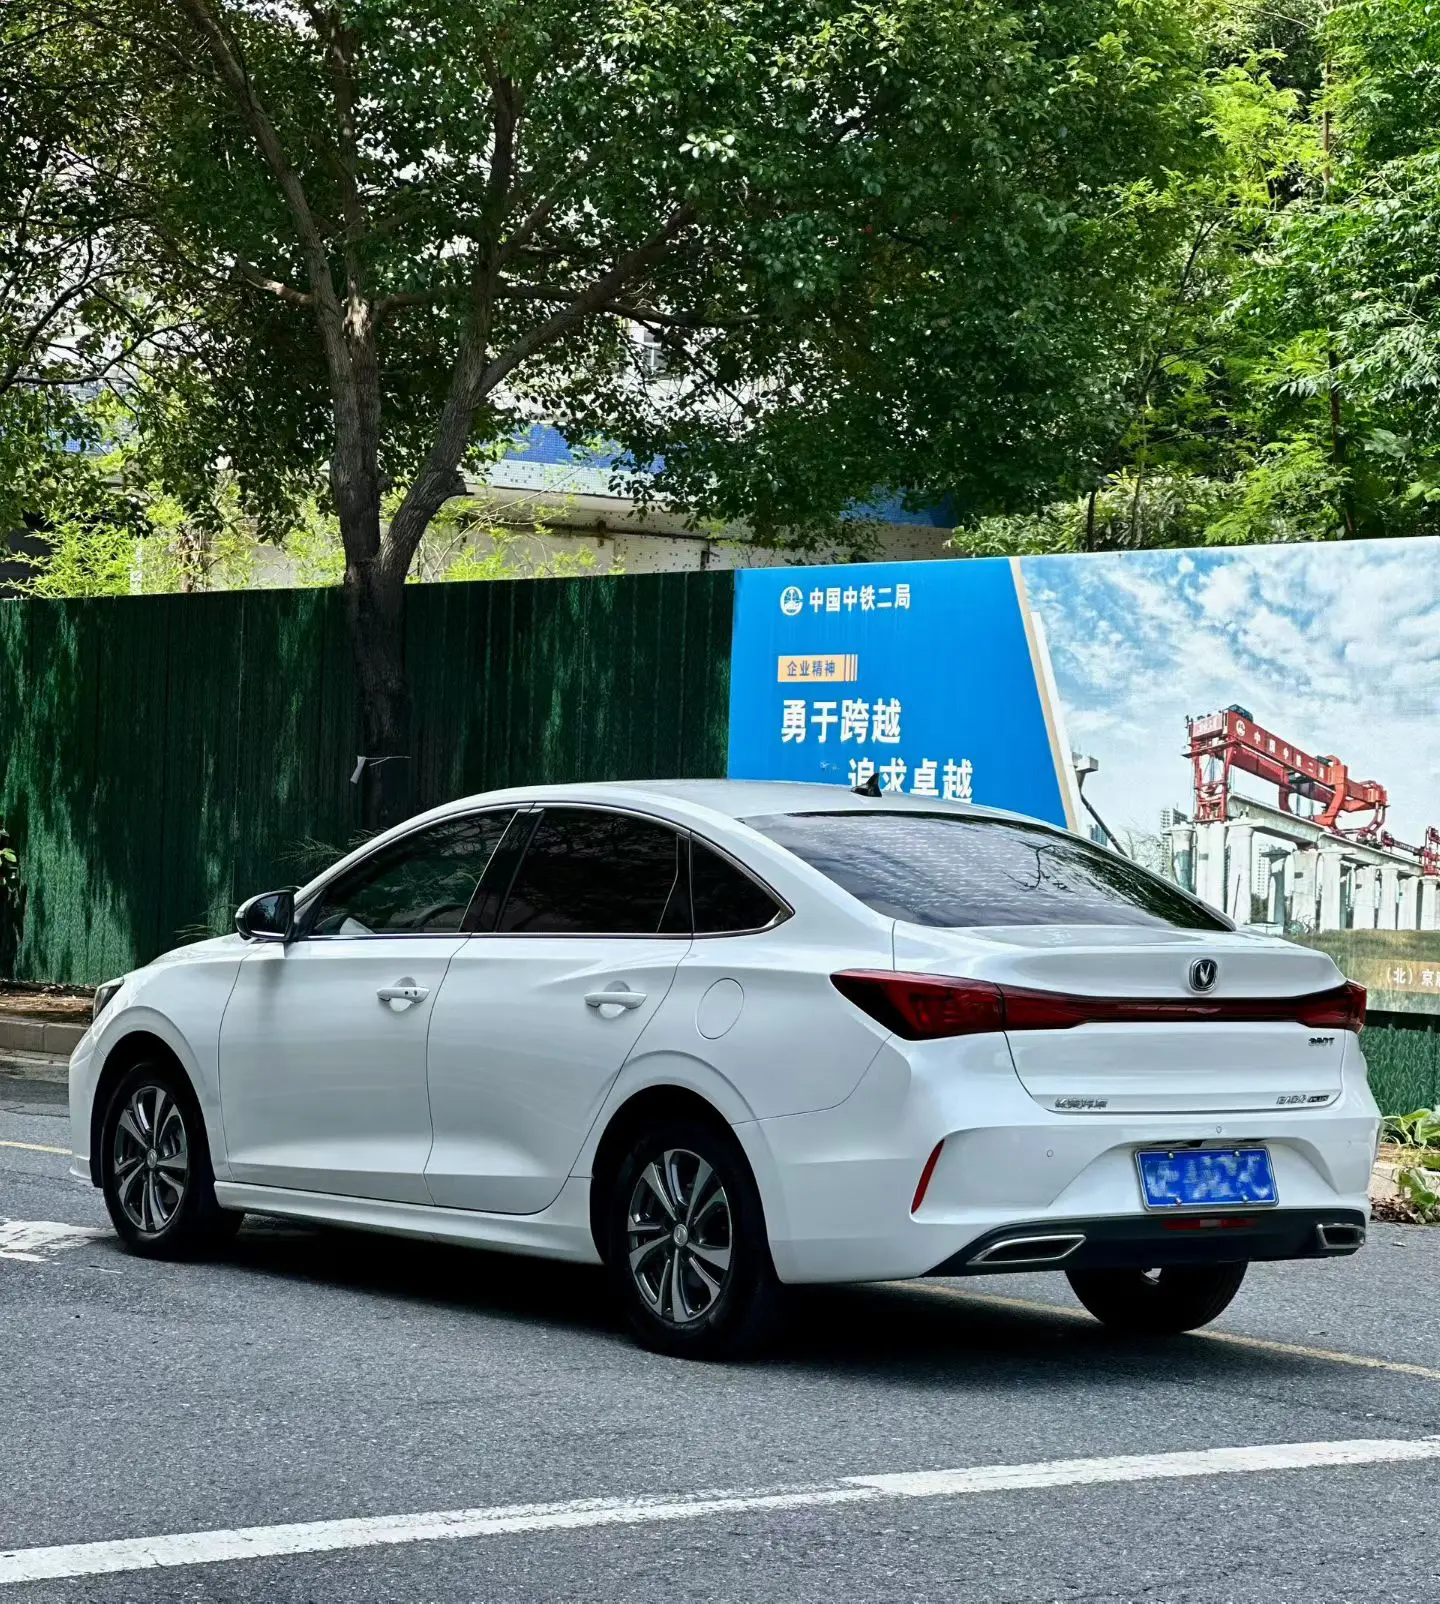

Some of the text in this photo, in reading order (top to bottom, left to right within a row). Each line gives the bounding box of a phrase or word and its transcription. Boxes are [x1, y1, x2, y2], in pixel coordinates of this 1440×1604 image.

[809, 584, 911, 613] 中国中铁二局
[787, 660, 836, 677] 企业精神
[781, 698, 902, 744] 勇于跨越
[848, 757, 973, 804] 追求卓越
